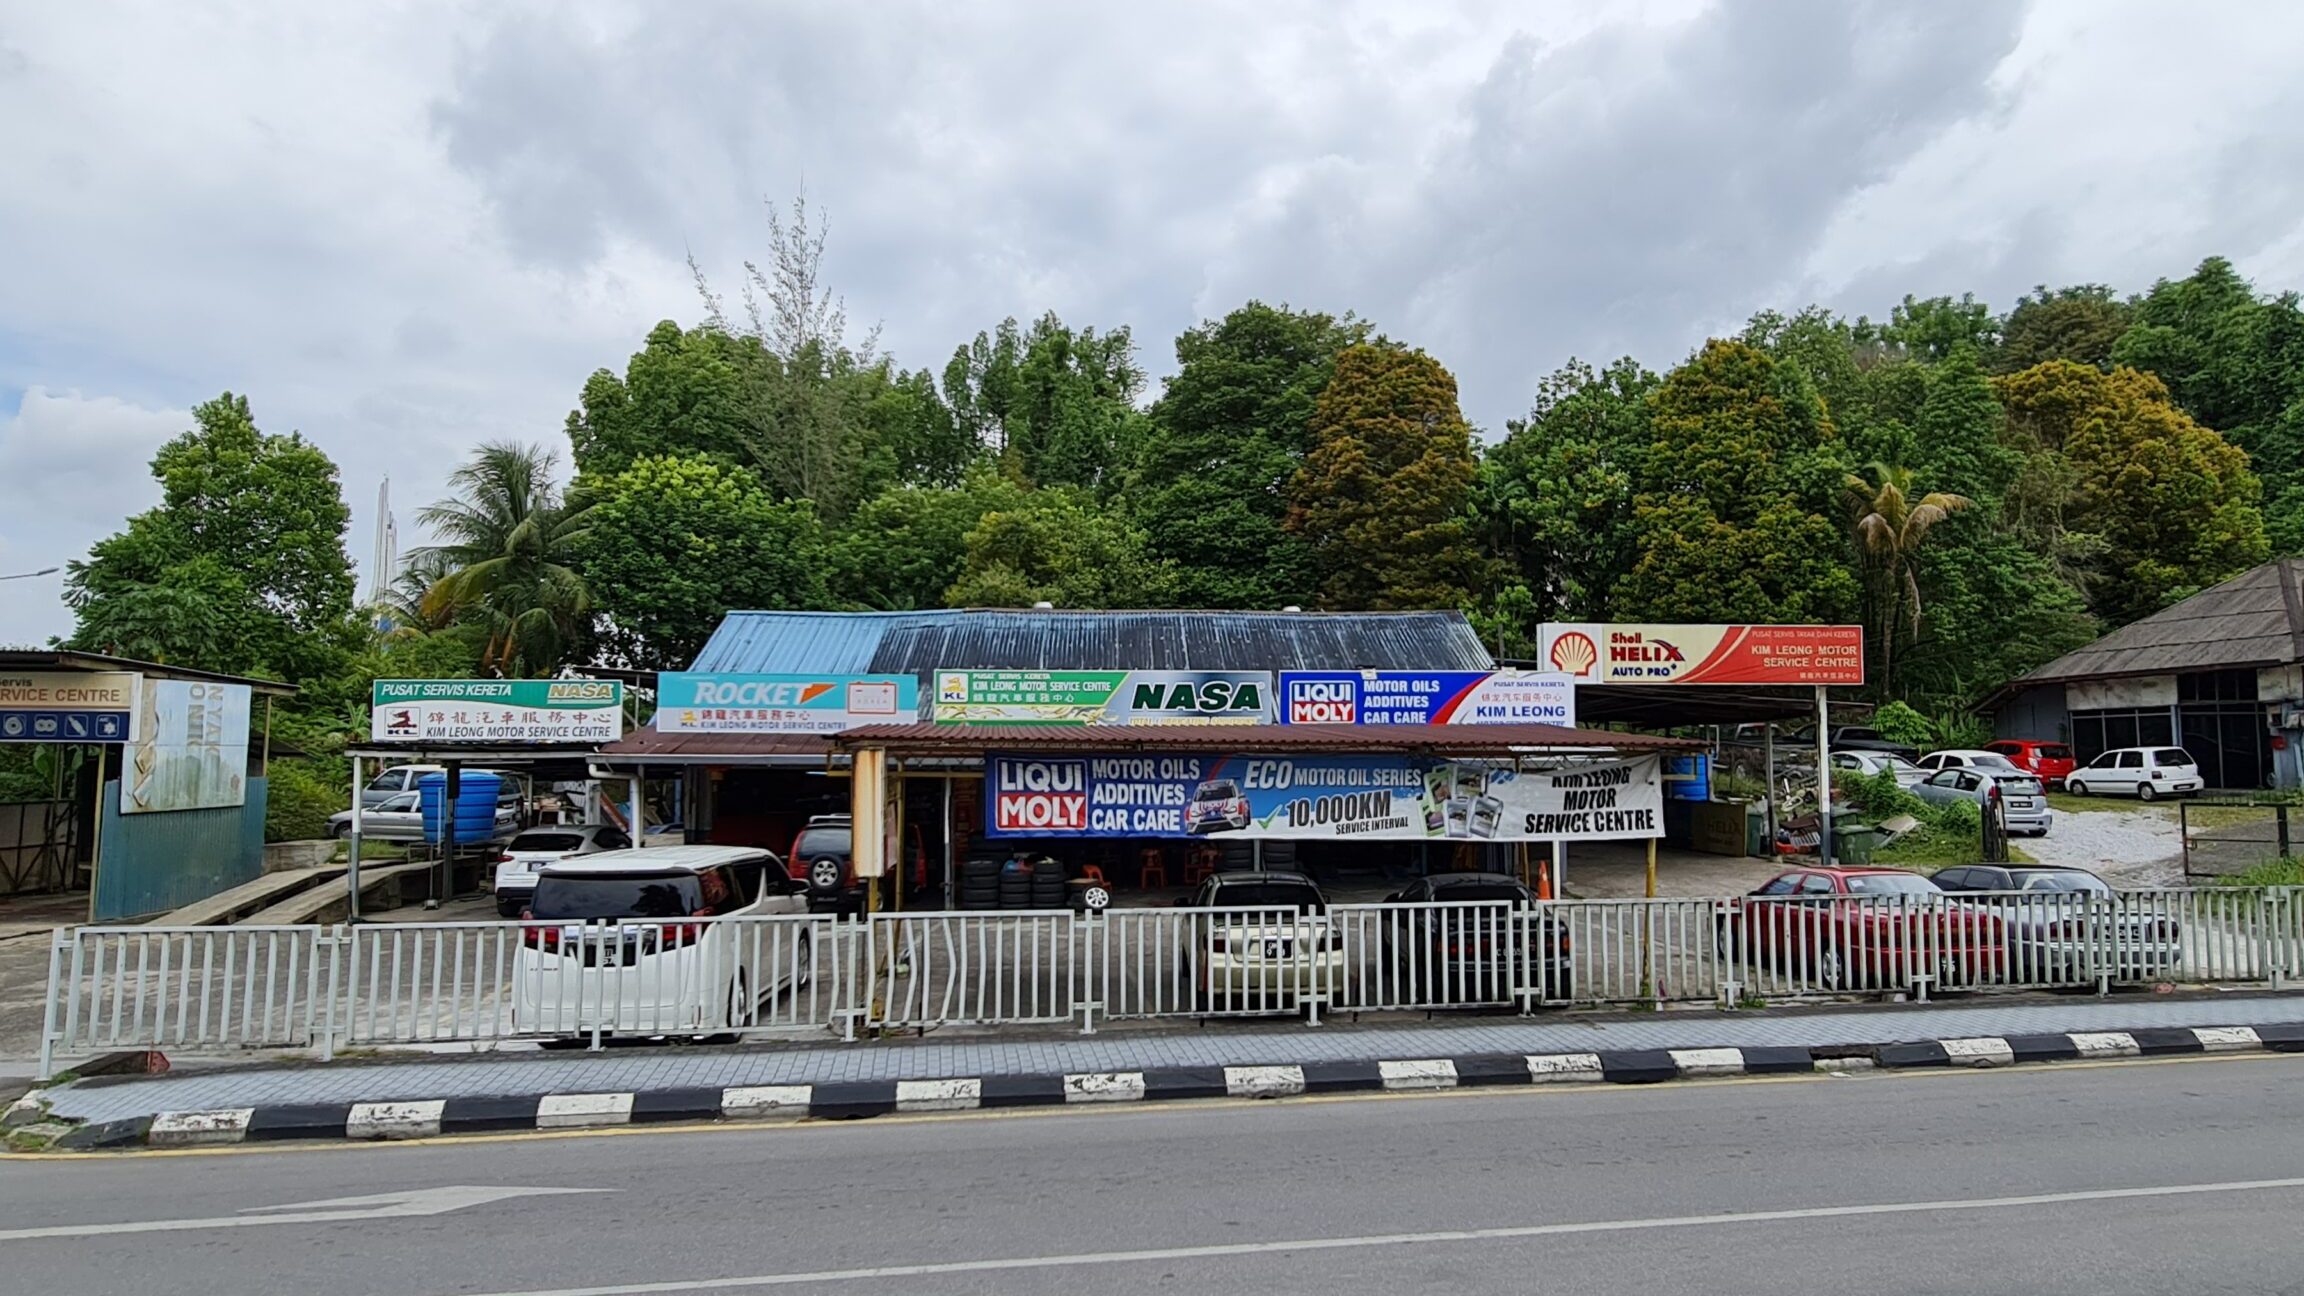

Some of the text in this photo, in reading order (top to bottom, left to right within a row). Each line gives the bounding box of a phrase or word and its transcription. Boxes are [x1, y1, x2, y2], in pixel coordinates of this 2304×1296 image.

[1611, 632, 1642, 644] Shell
[1610, 643, 1685, 662] HELIX
[1751, 645, 1857, 655] KIM LEONG MOTOR
[1763, 657, 1857, 668] SERVICE CENTRE
[1612, 667, 1670, 676] AUTO PRO
[0, 678, 33, 687] ervis
[381, 684, 512, 696] PUSAT SERVIS KERETA
[549, 683, 613, 698] NASA
[973, 682, 1111, 692] KIM LEONG MOTOR SERVICE CENTRE
[1364, 681, 1440, 692] MOTOR OILS
[56, 689, 120, 702] CENTRE
[693, 681, 807, 705] ROCKET
[1131, 681, 1263, 712] NASA
[1294, 683, 1351, 702] LIQUI
[1364, 696, 1429, 708] ADDITIVES
[1294, 703, 1352, 721] MOLY
[1364, 712, 1427, 724] CAR CARE
[1477, 706, 1565, 717] KIM LEONG
[427, 726, 611, 738] KIM LEONG MOTOR SERVICE CENTRE
[701, 721, 847, 730] KIM LEONG MOTOR SERVICE CENTRE
[1001, 762, 1082, 792] LIQUI
[1092, 759, 1200, 780] MOTOR OILS
[1244, 760, 1422, 790] ECO MOTOR OIL SERIES
[1092, 783, 1185, 805] ADDITIVES
[1563, 788, 1616, 811] MOTOR
[1001, 796, 1085, 826] MOLY
[1286, 789, 1392, 828] 10,000KM
[1092, 809, 1180, 831] CAR CARE
[1335, 817, 1408, 835] SERVICE INTERVAL
[1525, 809, 1655, 834] SERVICE CENTRE
